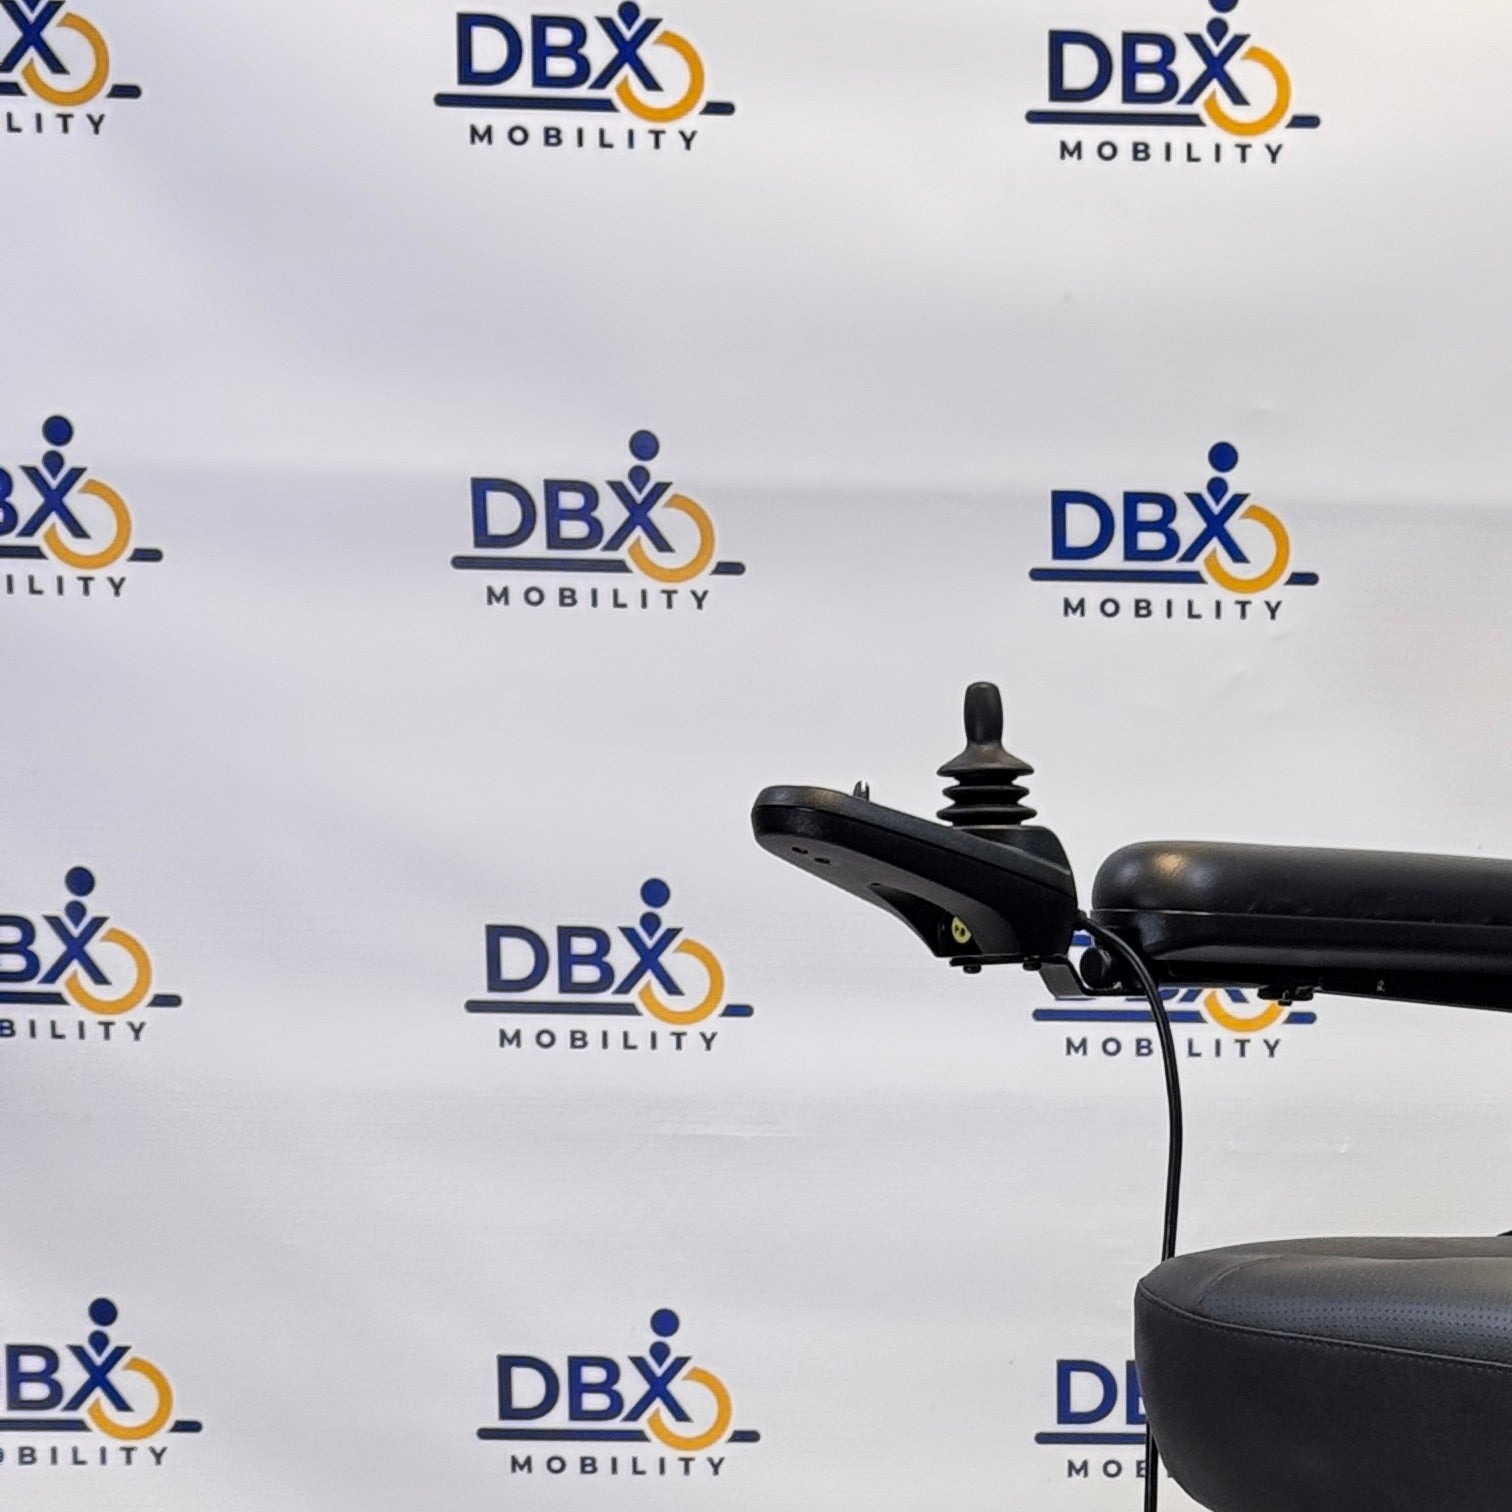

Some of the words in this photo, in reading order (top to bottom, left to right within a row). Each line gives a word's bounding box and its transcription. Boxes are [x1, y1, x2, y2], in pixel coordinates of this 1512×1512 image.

[457, 13, 663, 91] DBX
[1049, 30, 1250, 106] DBX
[7, 112, 105, 135] LITY
[470, 124, 697, 150] MOBILITY
[1060, 141, 1282, 163] MOBILITY
[471, 477, 675, 553] DBX
[1051, 490, 1250, 564] DBX
[7, 574, 125, 597] ILITY
[487, 586, 708, 610] MOBILITY
[1064, 598, 1281, 620] MOBILITY
[0, 914, 112, 985] BX
[485, 924, 684, 996] DBX
[0, 1019, 145, 1041] BILITY
[499, 1029, 717, 1051] MOBILITY
[1066, 1037, 1279, 1057] MOBLITY
[6, 1344, 134, 1412] BX
[497, 1355, 692, 1422] DBX
[0, 1446, 167, 1465] BILITY
[511, 1455, 724, 1476] MOBILITY
